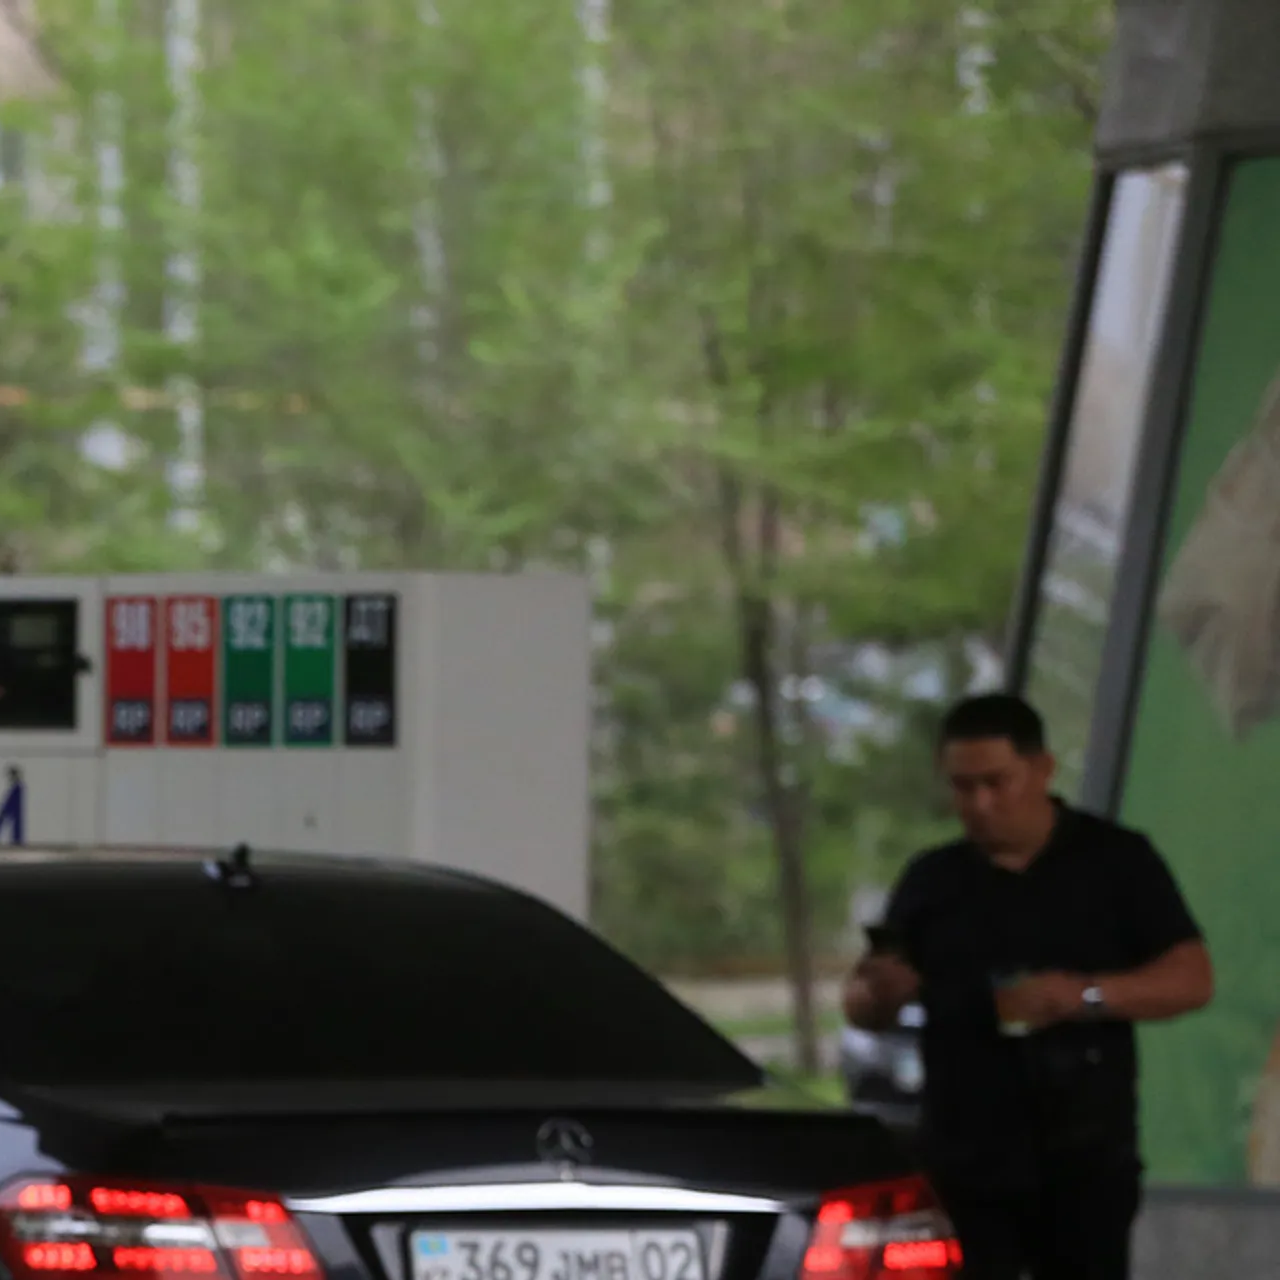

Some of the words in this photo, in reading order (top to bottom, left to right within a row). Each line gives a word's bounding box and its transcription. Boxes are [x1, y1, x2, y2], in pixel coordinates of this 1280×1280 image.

[114, 599, 151, 650] 98
[171, 600, 211, 650] 95
[229, 599, 267, 649] 92
[289, 599, 328, 648] 92
